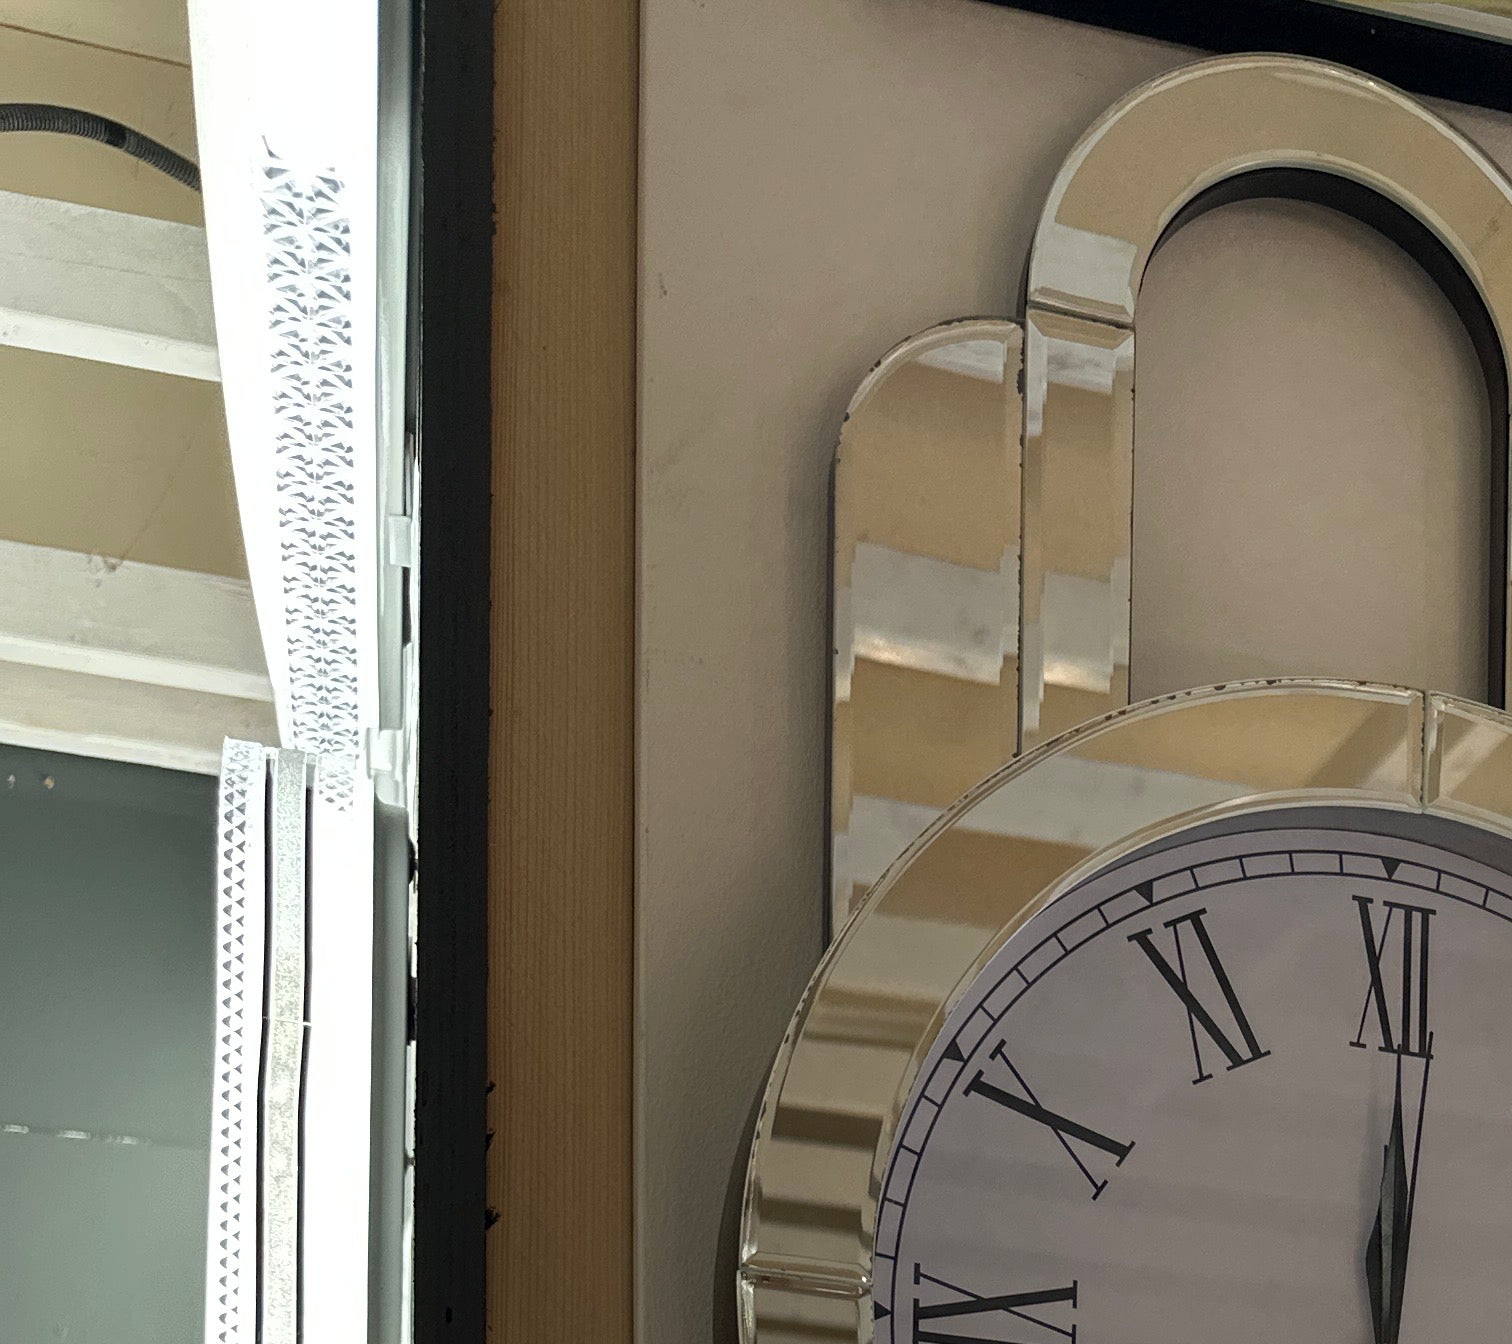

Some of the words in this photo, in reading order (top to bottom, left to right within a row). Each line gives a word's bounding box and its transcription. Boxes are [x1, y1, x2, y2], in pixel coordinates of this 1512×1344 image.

[1128, 909, 1271, 1084] XI
[1349, 896, 1436, 1059] XII
[963, 1040, 1135, 1200] X
